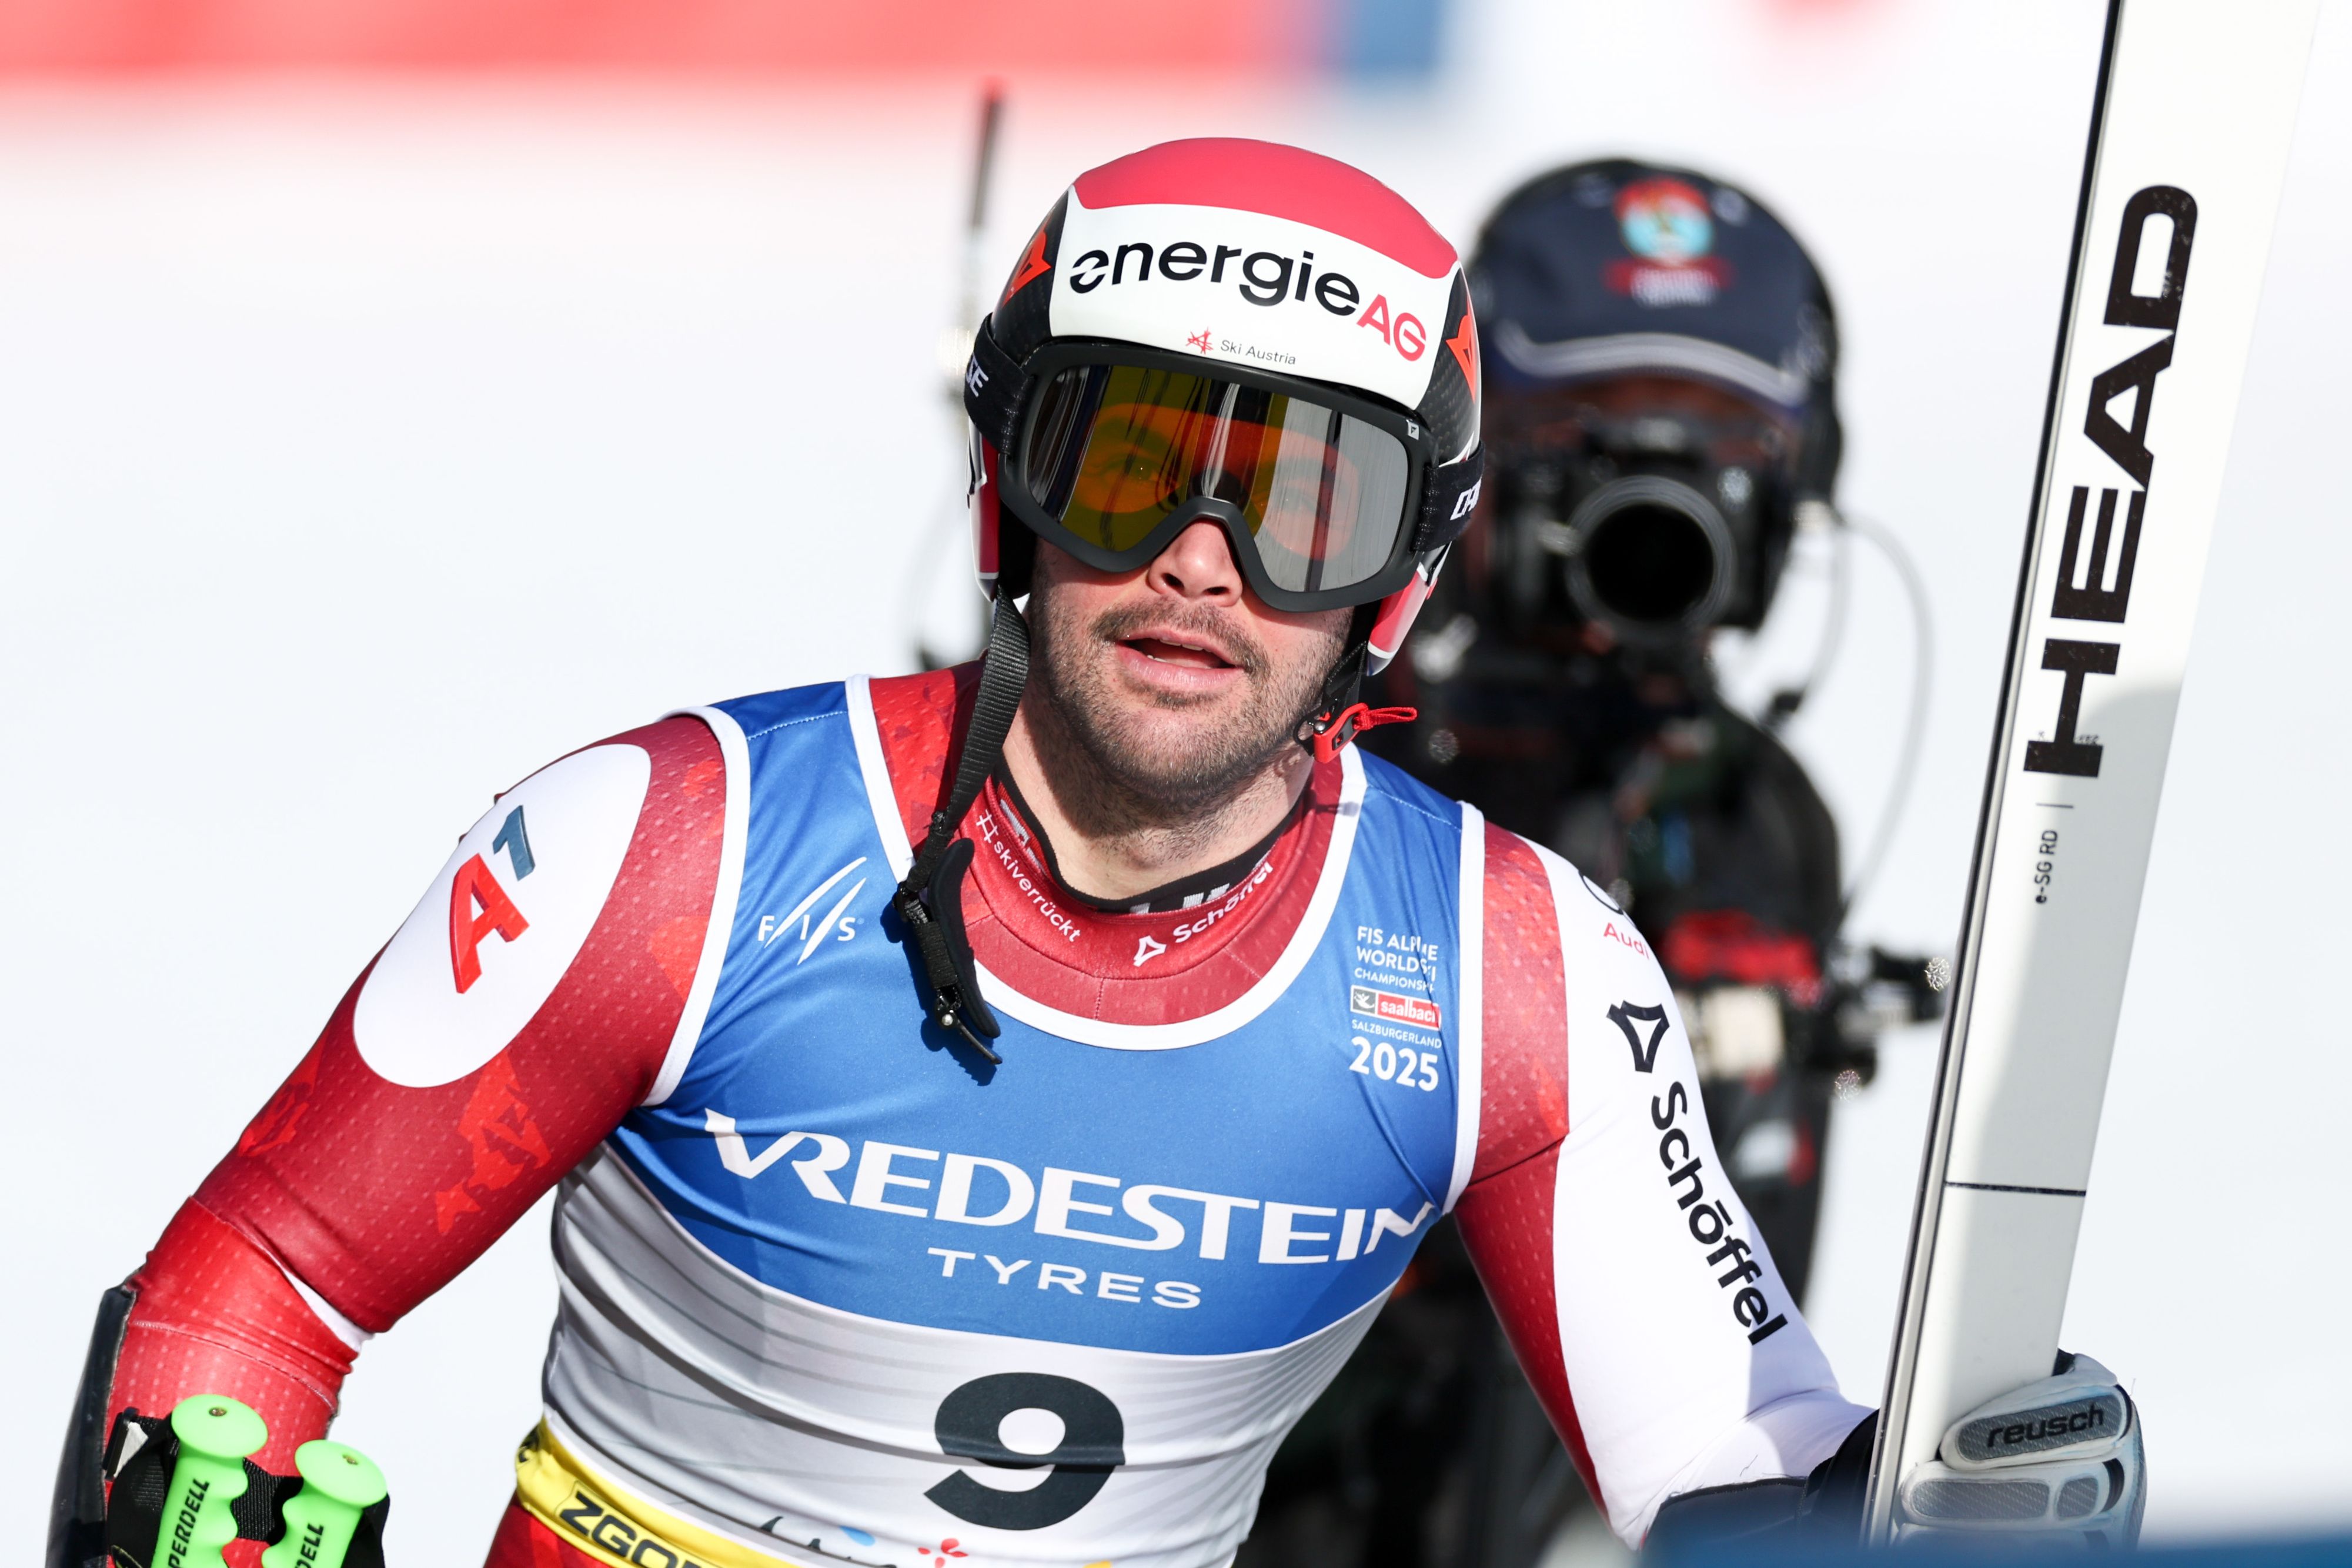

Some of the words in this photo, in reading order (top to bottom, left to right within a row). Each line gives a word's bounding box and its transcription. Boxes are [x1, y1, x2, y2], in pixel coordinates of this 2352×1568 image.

[1220, 339, 1242, 355] Ski
[1245, 346, 1297, 365] Austria
[2023, 185, 2197, 778] HEAD
[2039, 830, 2059, 855] RD
[449, 804, 536, 994] A1
[2034, 861, 2053, 904] e-SG
[1357, 925, 1384, 945] FIS
[1352, 1019, 1442, 1048] SALZBURGERLAND
[1349, 1036, 1439, 1092] 2025
[704, 1108, 1435, 1265] VREDESTEIN
[927, 1246, 1202, 1309] TYRES
[923, 1372, 1125, 1531] 9
[1987, 1403, 2103, 1447] reusch
[559, 1490, 701, 1568] ZGO
